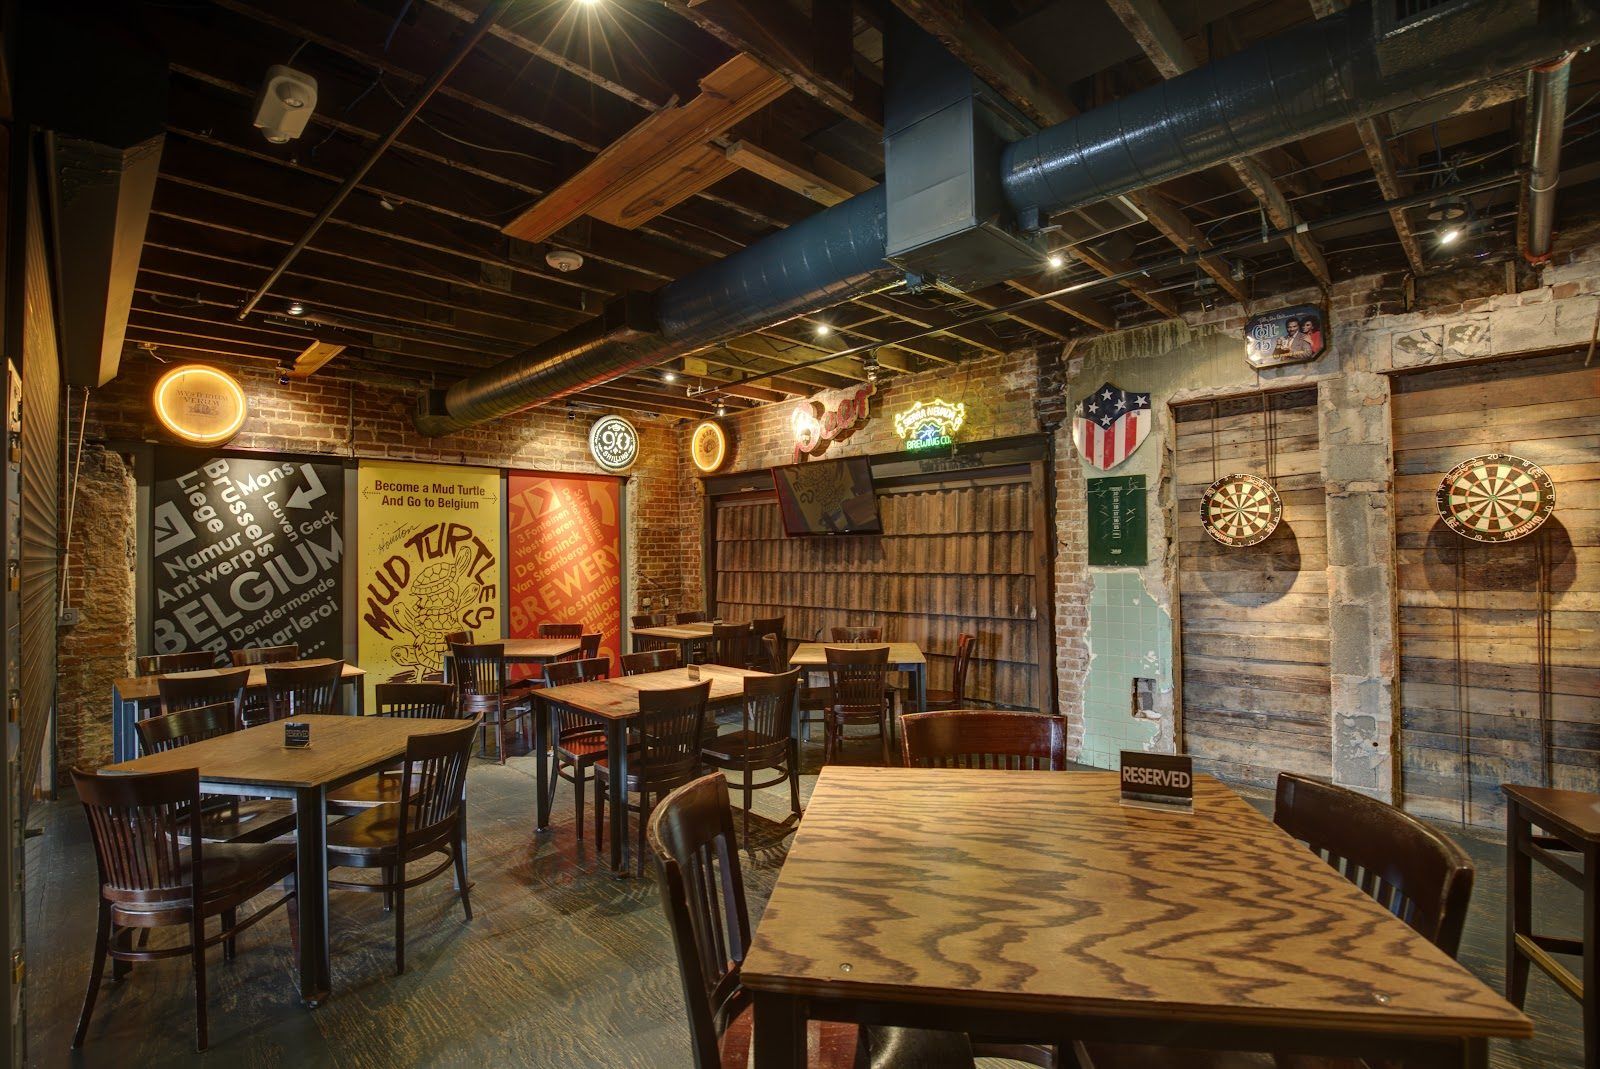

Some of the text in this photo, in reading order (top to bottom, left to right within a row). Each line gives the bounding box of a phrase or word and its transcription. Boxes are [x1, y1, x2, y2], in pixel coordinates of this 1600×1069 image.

[1251, 323, 1280, 340] Colt
[602, 431, 632, 452] 90
[906, 436, 940, 450] BREWING
[176, 470, 224, 533] Liege
[235, 462, 295, 497] Mons
[375, 480, 486, 496] Become a Mud Turtle
[381, 495, 479, 511] And Go to Belgium
[203, 458, 275, 558] Brussels
[262, 491, 299, 543] Leuven
[300, 510, 339, 536] Geck
[162, 532, 244, 579] Namur
[514, 530, 582, 578] De Koninck
[154, 525, 343, 656] BELGIUM
[157, 549, 256, 610] Antwerp
[363, 522, 496, 641] MUD TURTLES
[510, 537, 620, 634] BREWERY
[512, 577, 535, 595] Van
[553, 574, 620, 624] Westmalle
[230, 577, 336, 643] Dendermonde
[577, 595, 619, 628] ntillon
[1122, 765, 1191, 789] RESERVED
